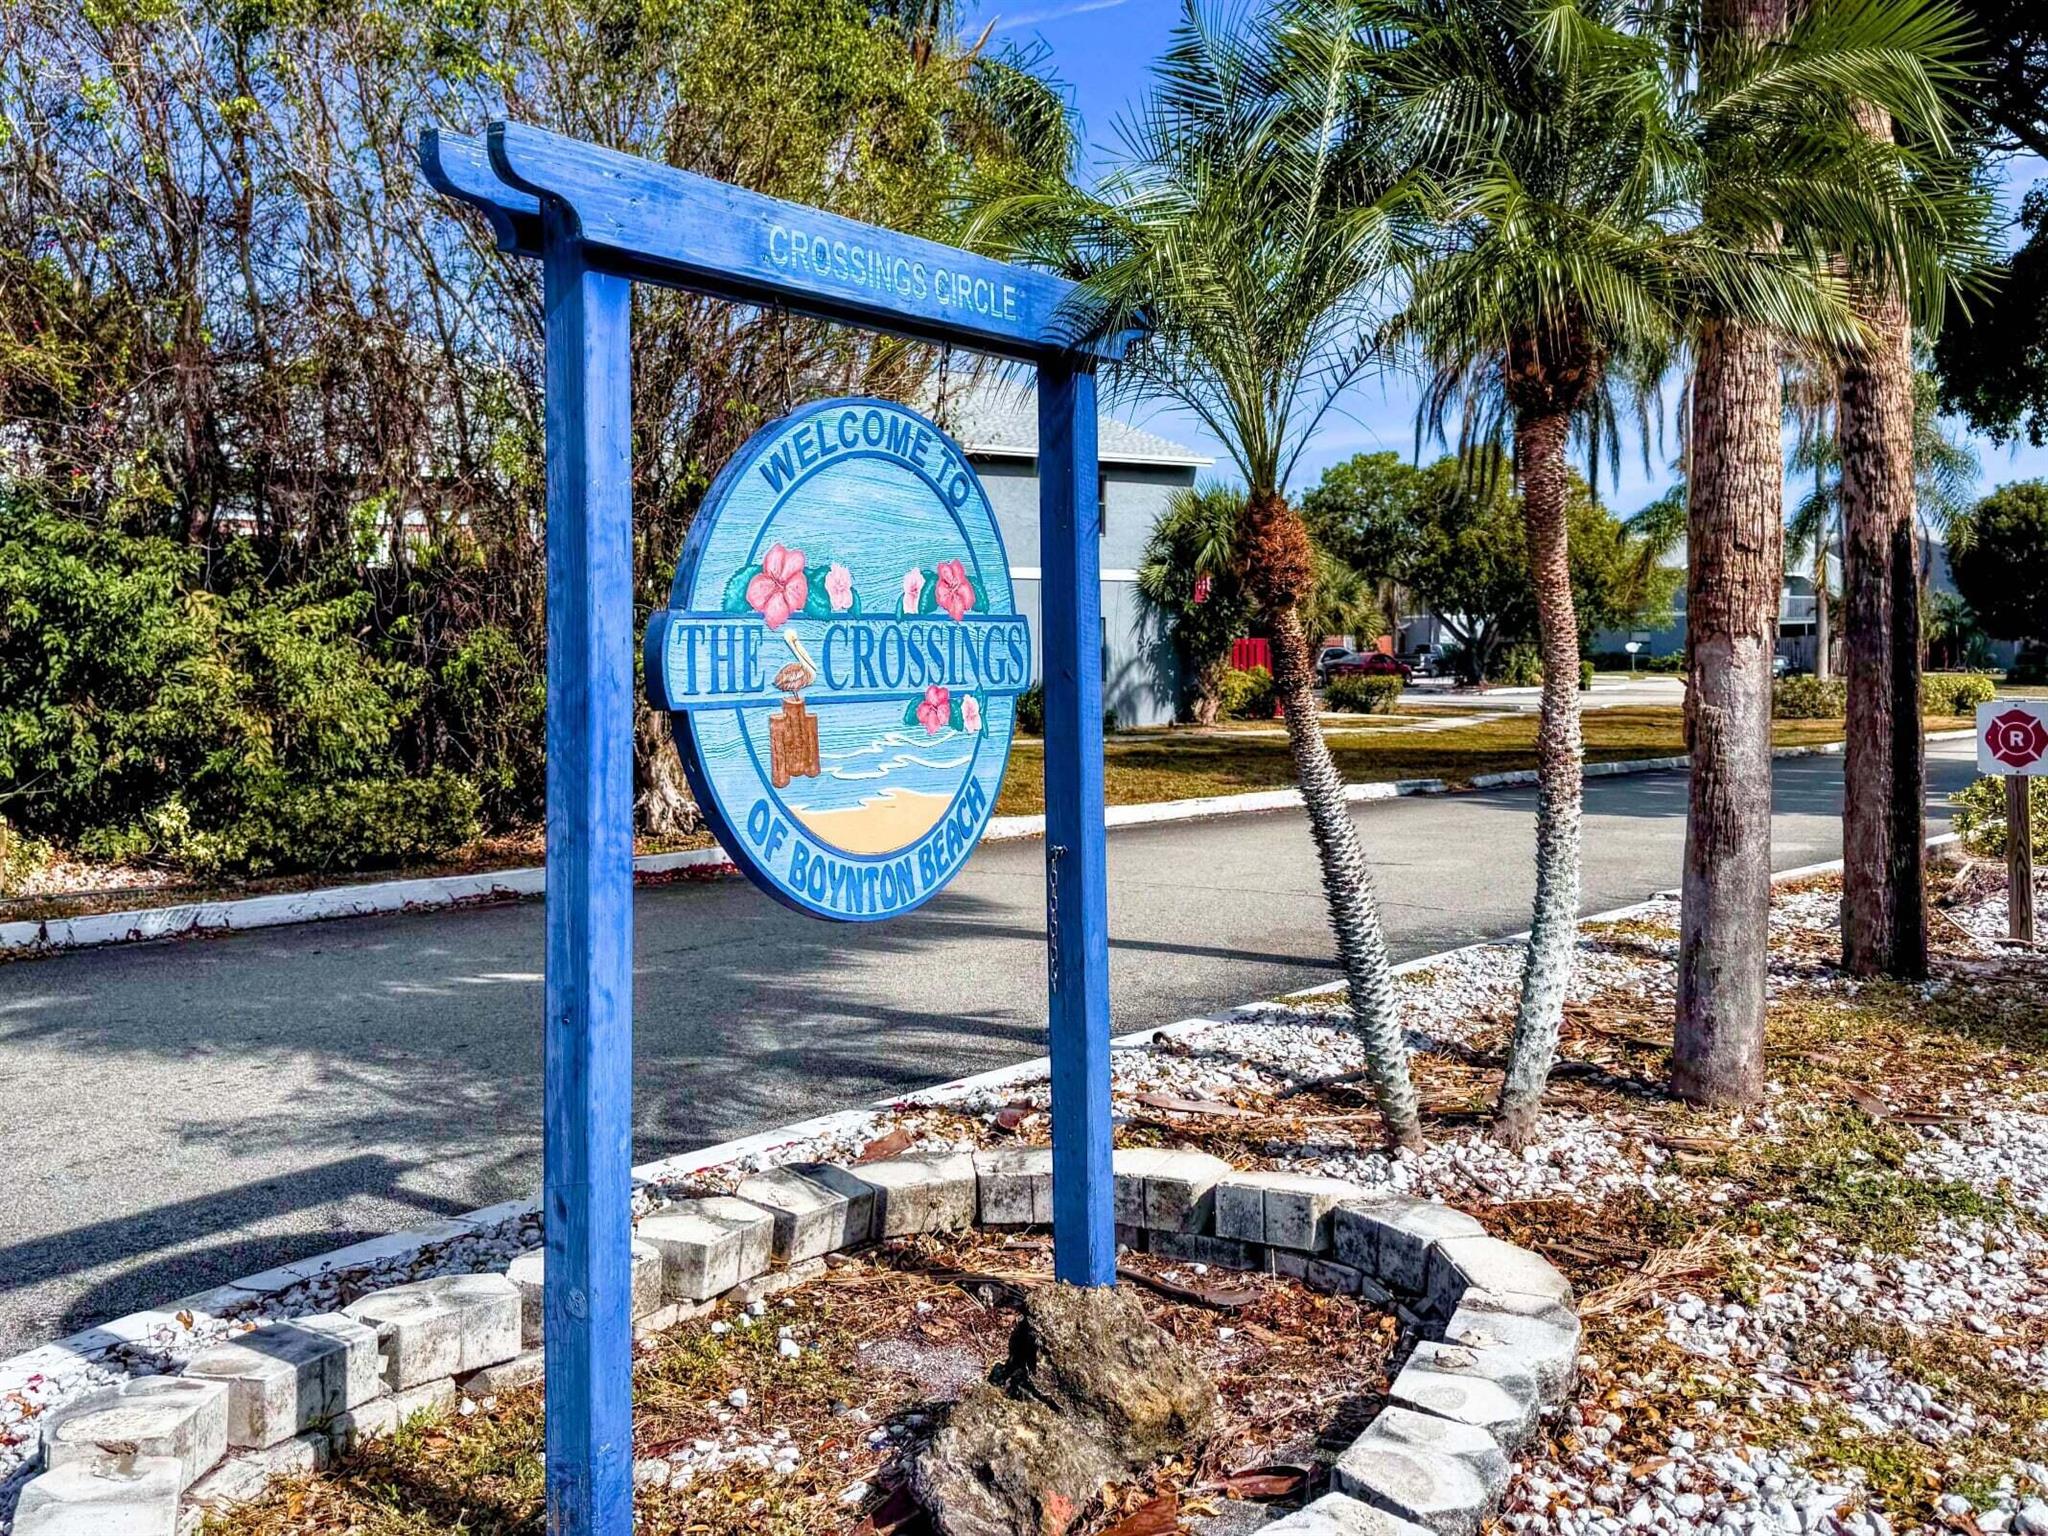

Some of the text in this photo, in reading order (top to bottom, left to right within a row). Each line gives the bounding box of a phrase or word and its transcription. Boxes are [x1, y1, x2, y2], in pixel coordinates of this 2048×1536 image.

[769, 225, 1018, 321] CROSSINGS CIRCLE
[759, 410, 970, 508] WELCOME TO
[677, 624, 1023, 695] THE CROSSINGS
[2009, 730, 2024, 747] R
[747, 775, 987, 913] OF BOYNTON BEACH
